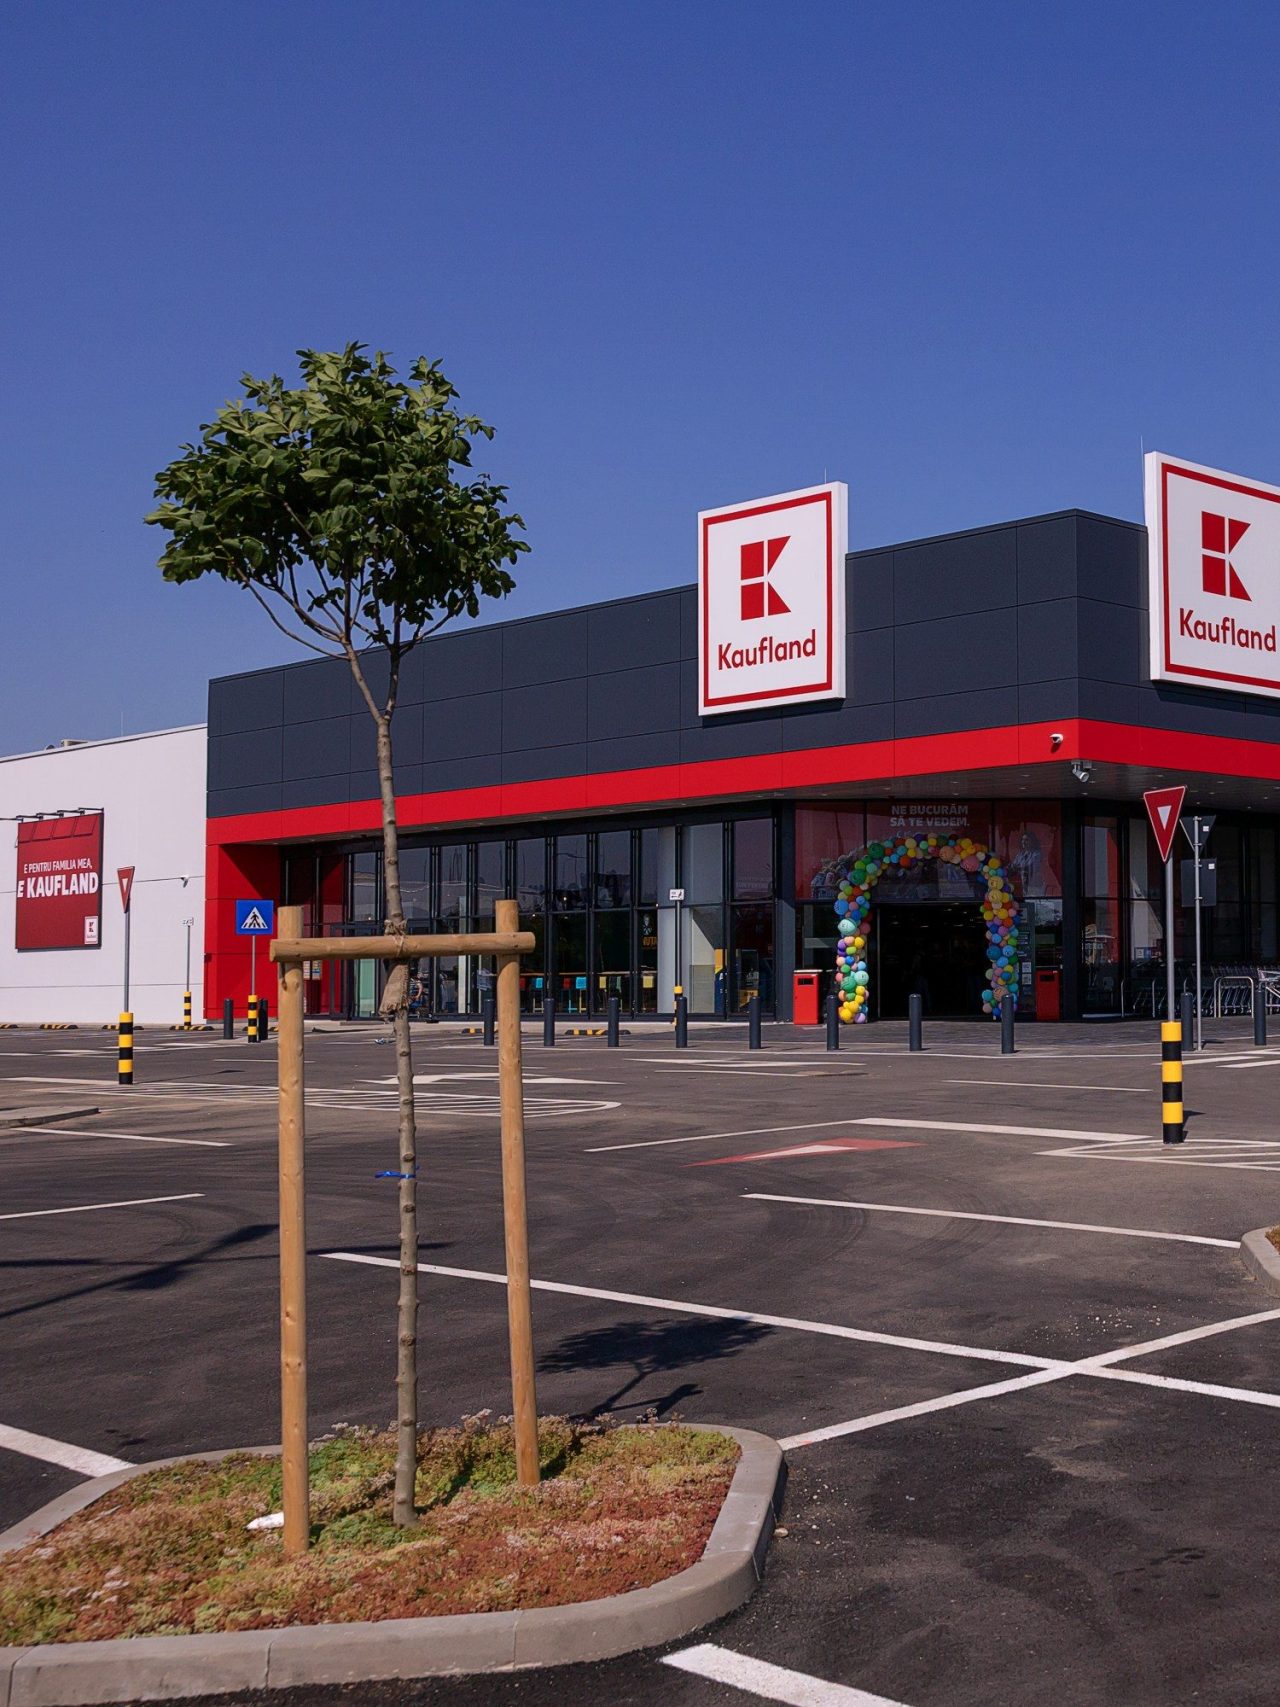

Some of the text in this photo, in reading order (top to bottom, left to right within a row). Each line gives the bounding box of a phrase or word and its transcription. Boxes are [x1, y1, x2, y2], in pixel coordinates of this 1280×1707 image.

[1201, 510, 1252, 602] K
[740, 535, 792, 621] K
[1179, 607, 1277, 652] Kaufland
[718, 628, 816, 671] Kaufland
[891, 805, 908, 815] NE
[908, 817, 923, 827] TE
[926, 817, 970, 827] VEDEM.
[28, 862, 52, 873] PENTRU
[52, 859, 77, 871] FAMILIA
[77, 858, 92, 869] MEA,
[17, 872, 99, 898] E KAUFLAND
